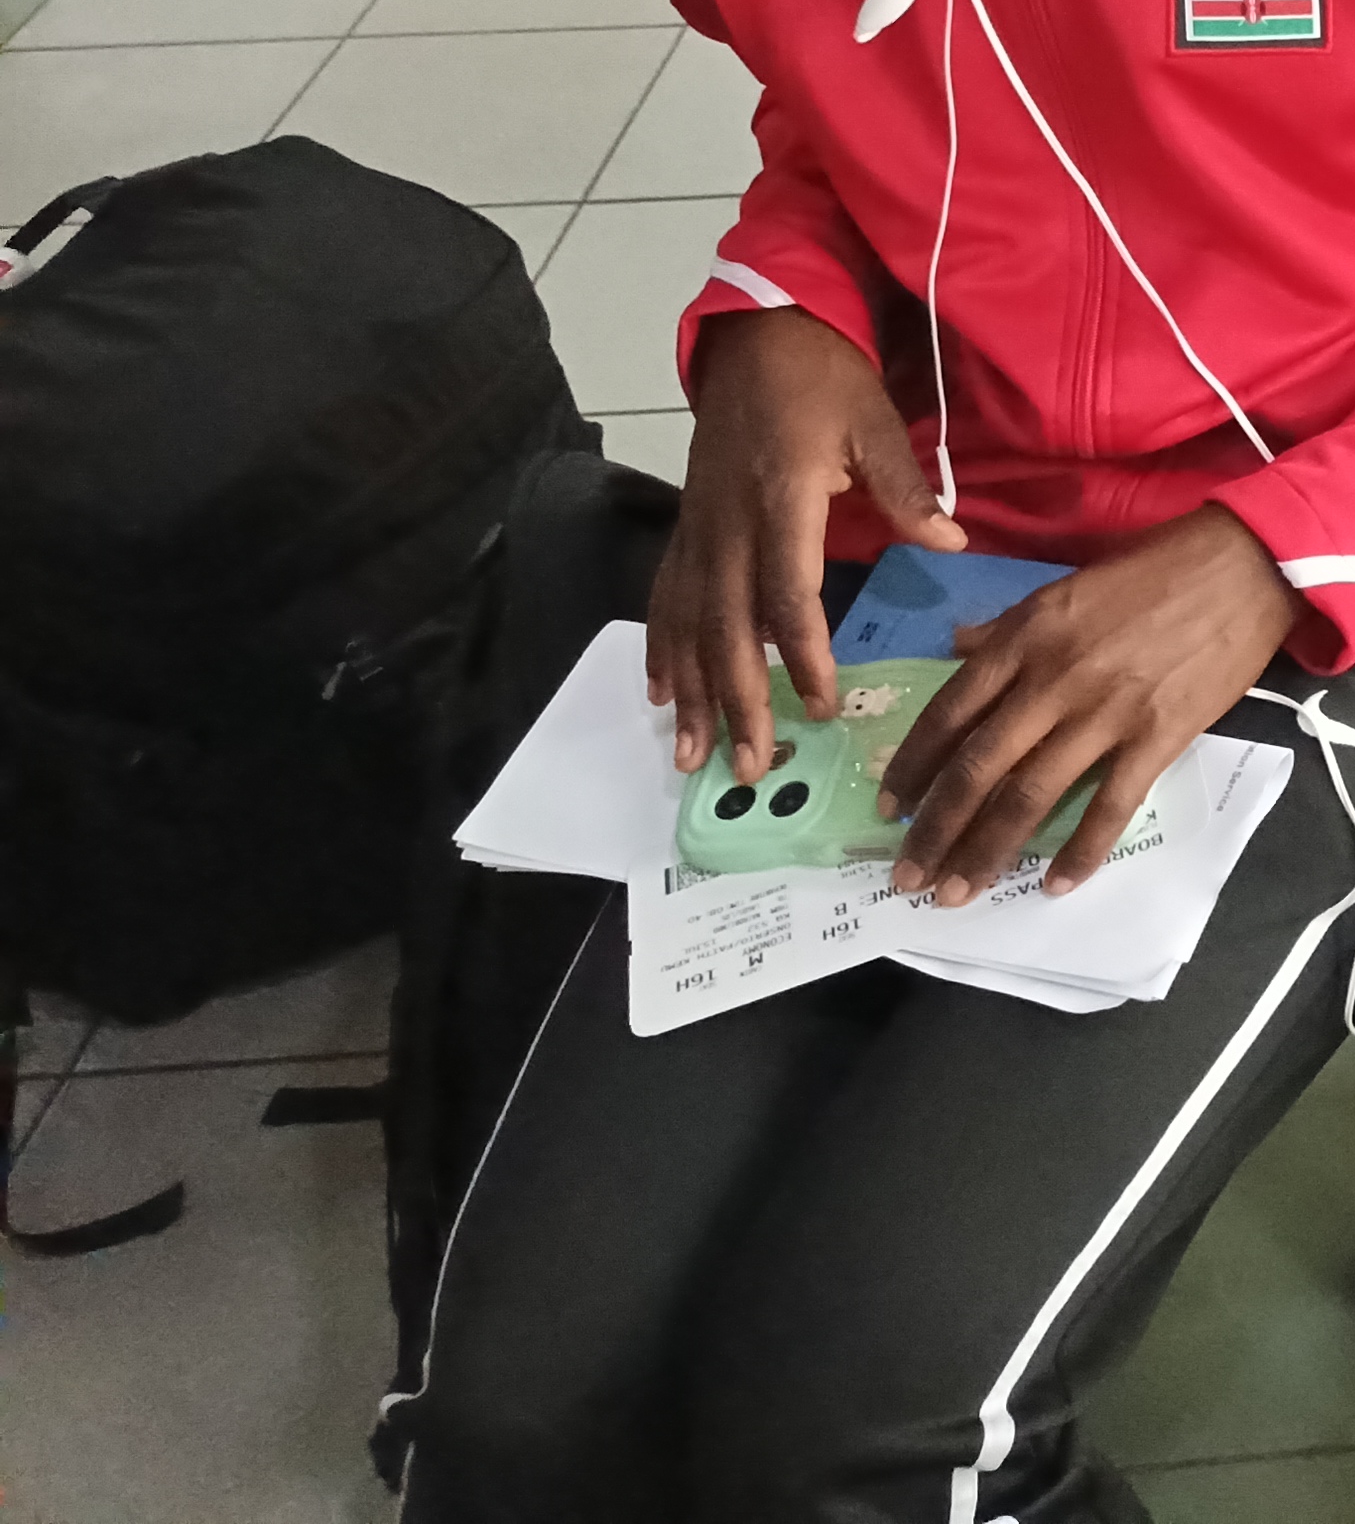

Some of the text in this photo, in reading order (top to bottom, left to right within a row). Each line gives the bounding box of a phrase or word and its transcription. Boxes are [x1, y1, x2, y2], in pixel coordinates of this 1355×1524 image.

[1215, 770, 1243, 813] Service
[990, 876, 1044, 906] PASS
[834, 902, 848, 916] B
[821, 916, 863, 941] 16H
[742, 932, 793, 956] ECONOMY
[748, 952, 764, 967] M
[675, 969, 717, 993] 16H
